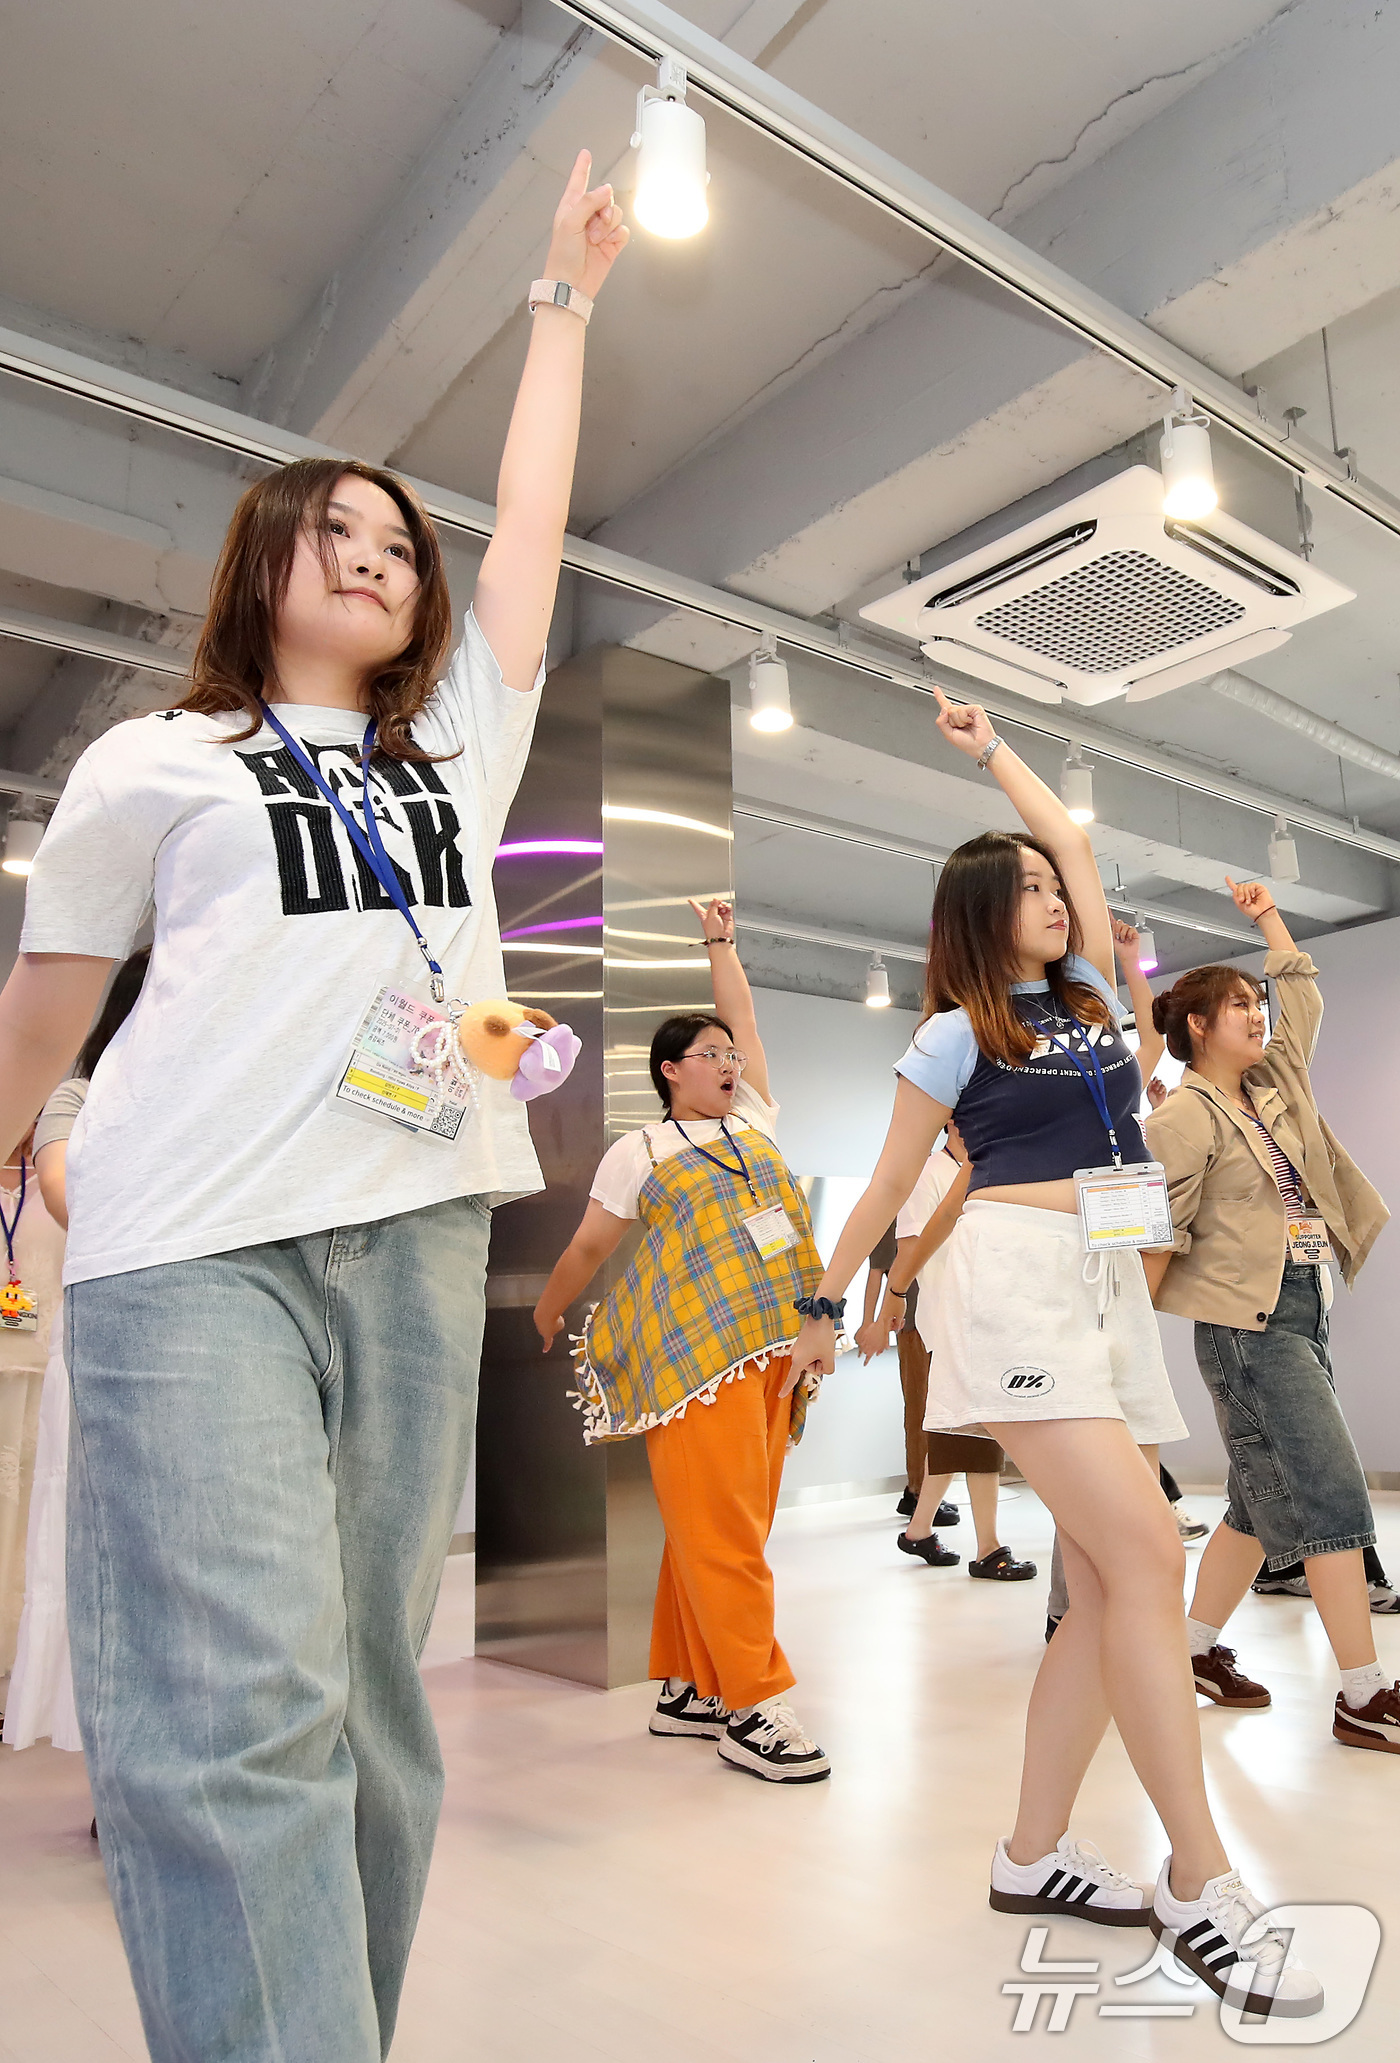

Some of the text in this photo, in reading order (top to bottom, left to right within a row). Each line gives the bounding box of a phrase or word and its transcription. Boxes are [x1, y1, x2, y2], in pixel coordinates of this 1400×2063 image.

[389, 994, 415, 1014] 이월드
[343, 1085, 351, 1093] To
[351, 1088, 371, 1101] check
[371, 1096, 401, 1112] schedule
[407, 1111, 424, 1121] more
